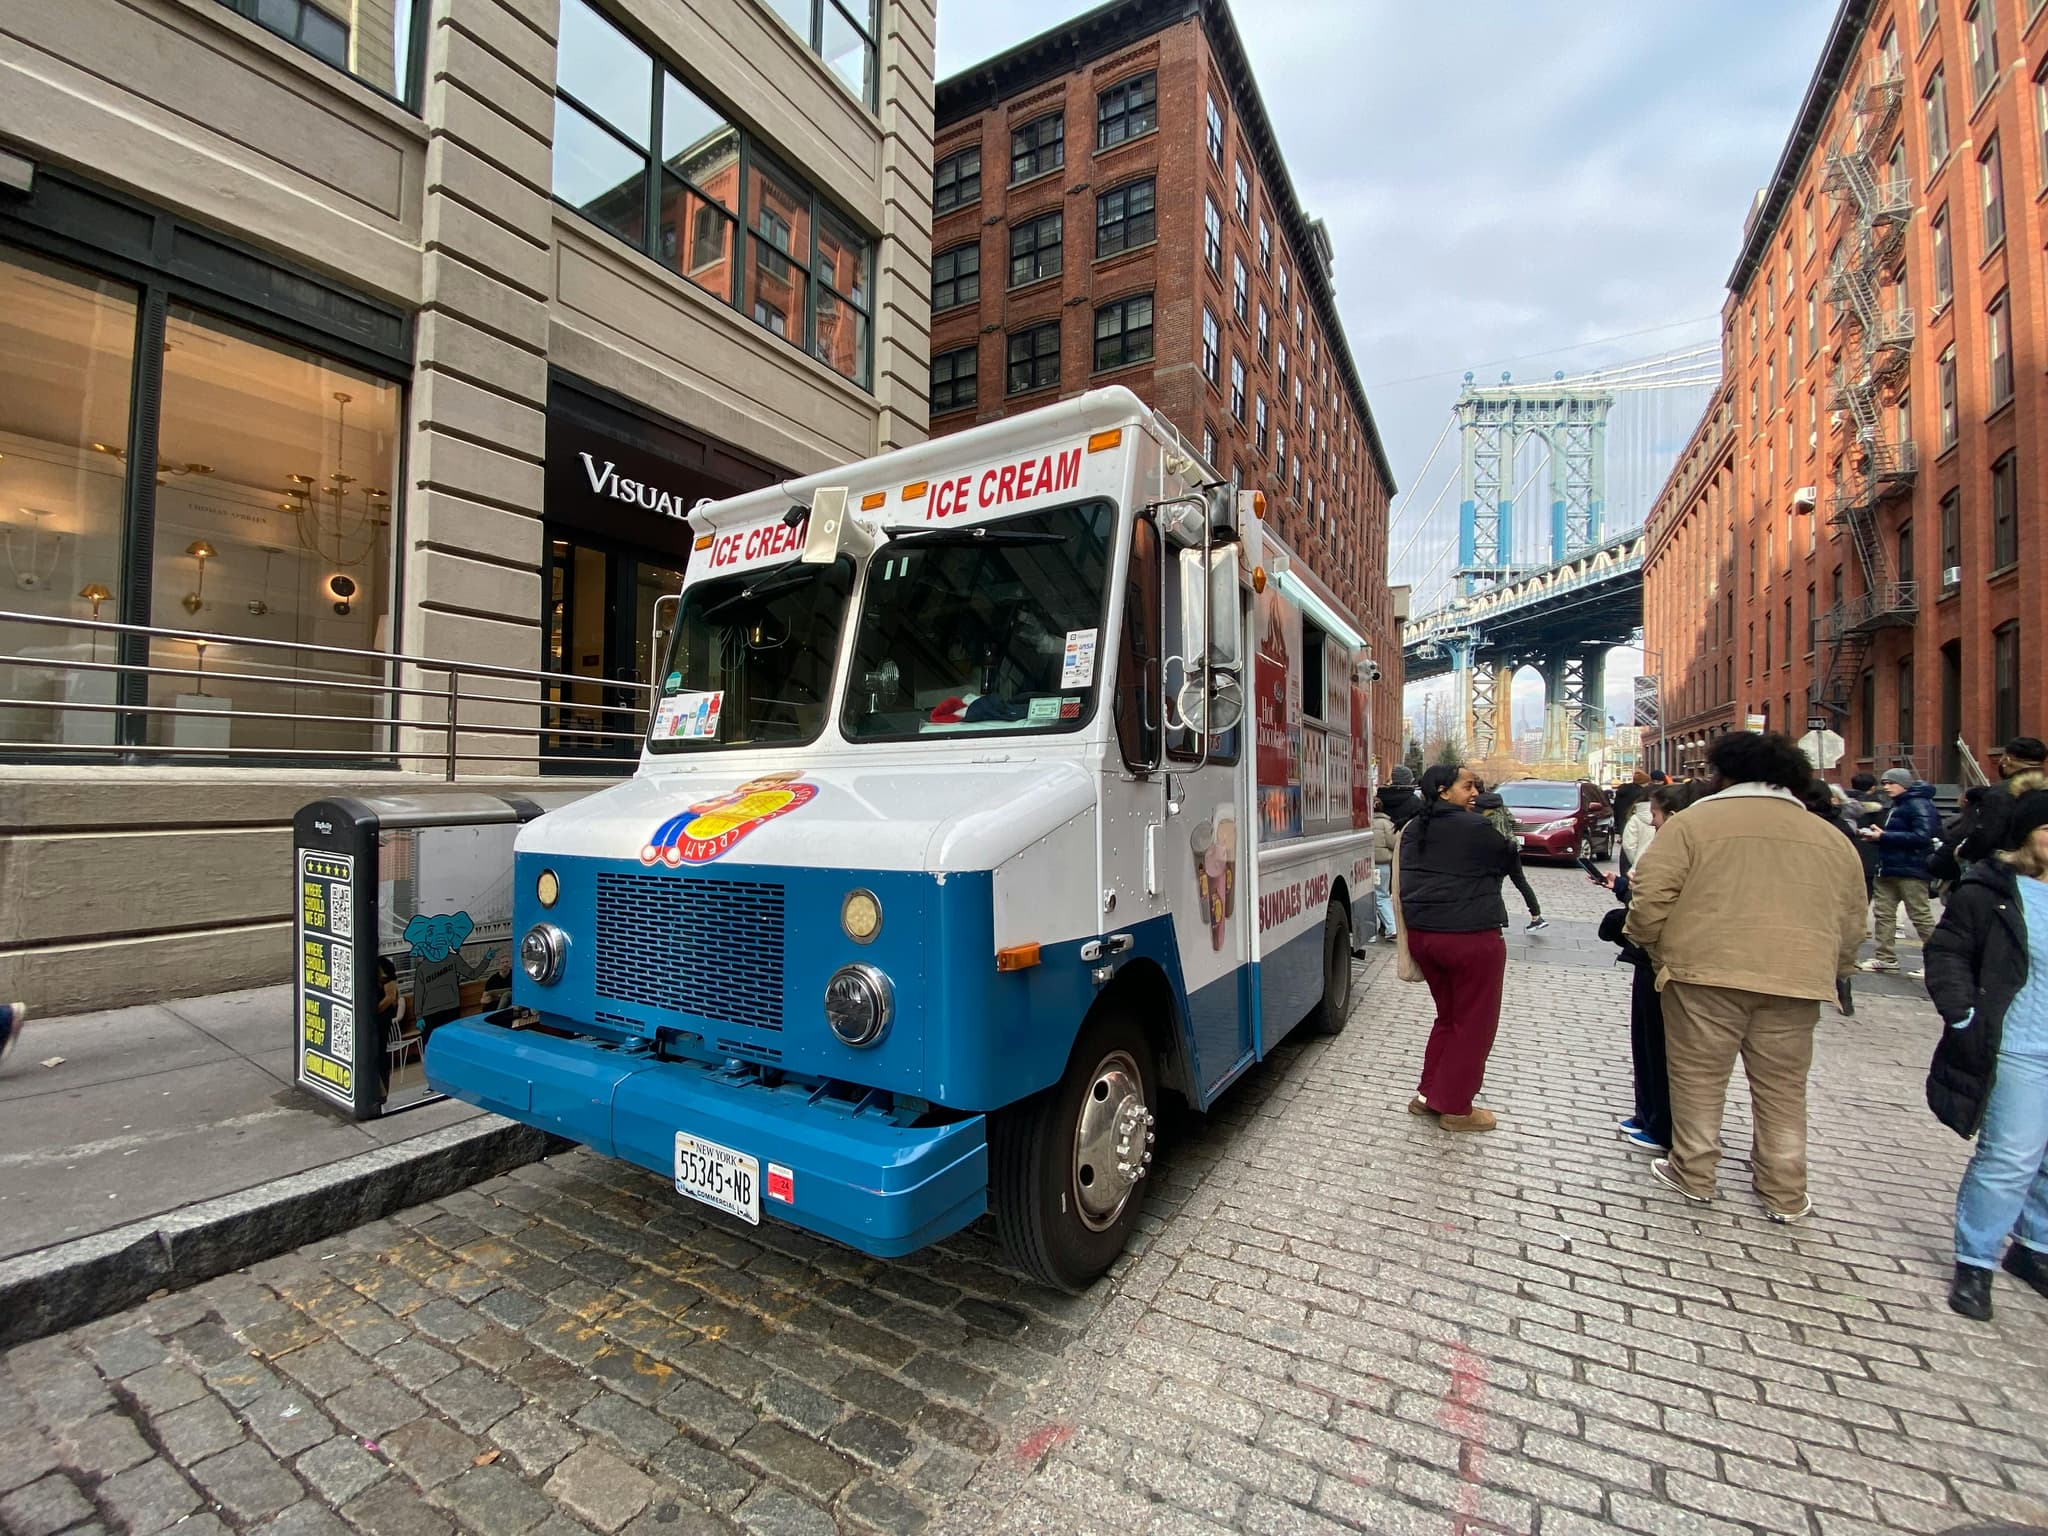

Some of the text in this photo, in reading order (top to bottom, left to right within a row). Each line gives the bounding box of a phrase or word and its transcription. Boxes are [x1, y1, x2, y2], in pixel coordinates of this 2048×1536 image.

[579, 451, 689, 521] VISUAL
[926, 447, 1082, 520] ICE CREAM
[708, 533, 744, 568] ICE
[1261, 695, 1274, 726] Hot
[684, 828, 740, 859] CREAM
[304, 882, 322, 898] WHERE
[304, 896, 325, 912] SHOULD
[1259, 872, 1329, 934] SUNDAES CONES
[304, 910, 314, 926] WE
[305, 941, 323, 958] WHERE
[305, 955, 326, 973] SHOULD
[305, 969, 315, 985] WE
[305, 1013, 326, 1032] SHOULD
[305, 1027, 314, 1043] WE
[695, 1142, 737, 1166] NEW YORK
[697, 1190, 737, 1211] COMMERCIAL
